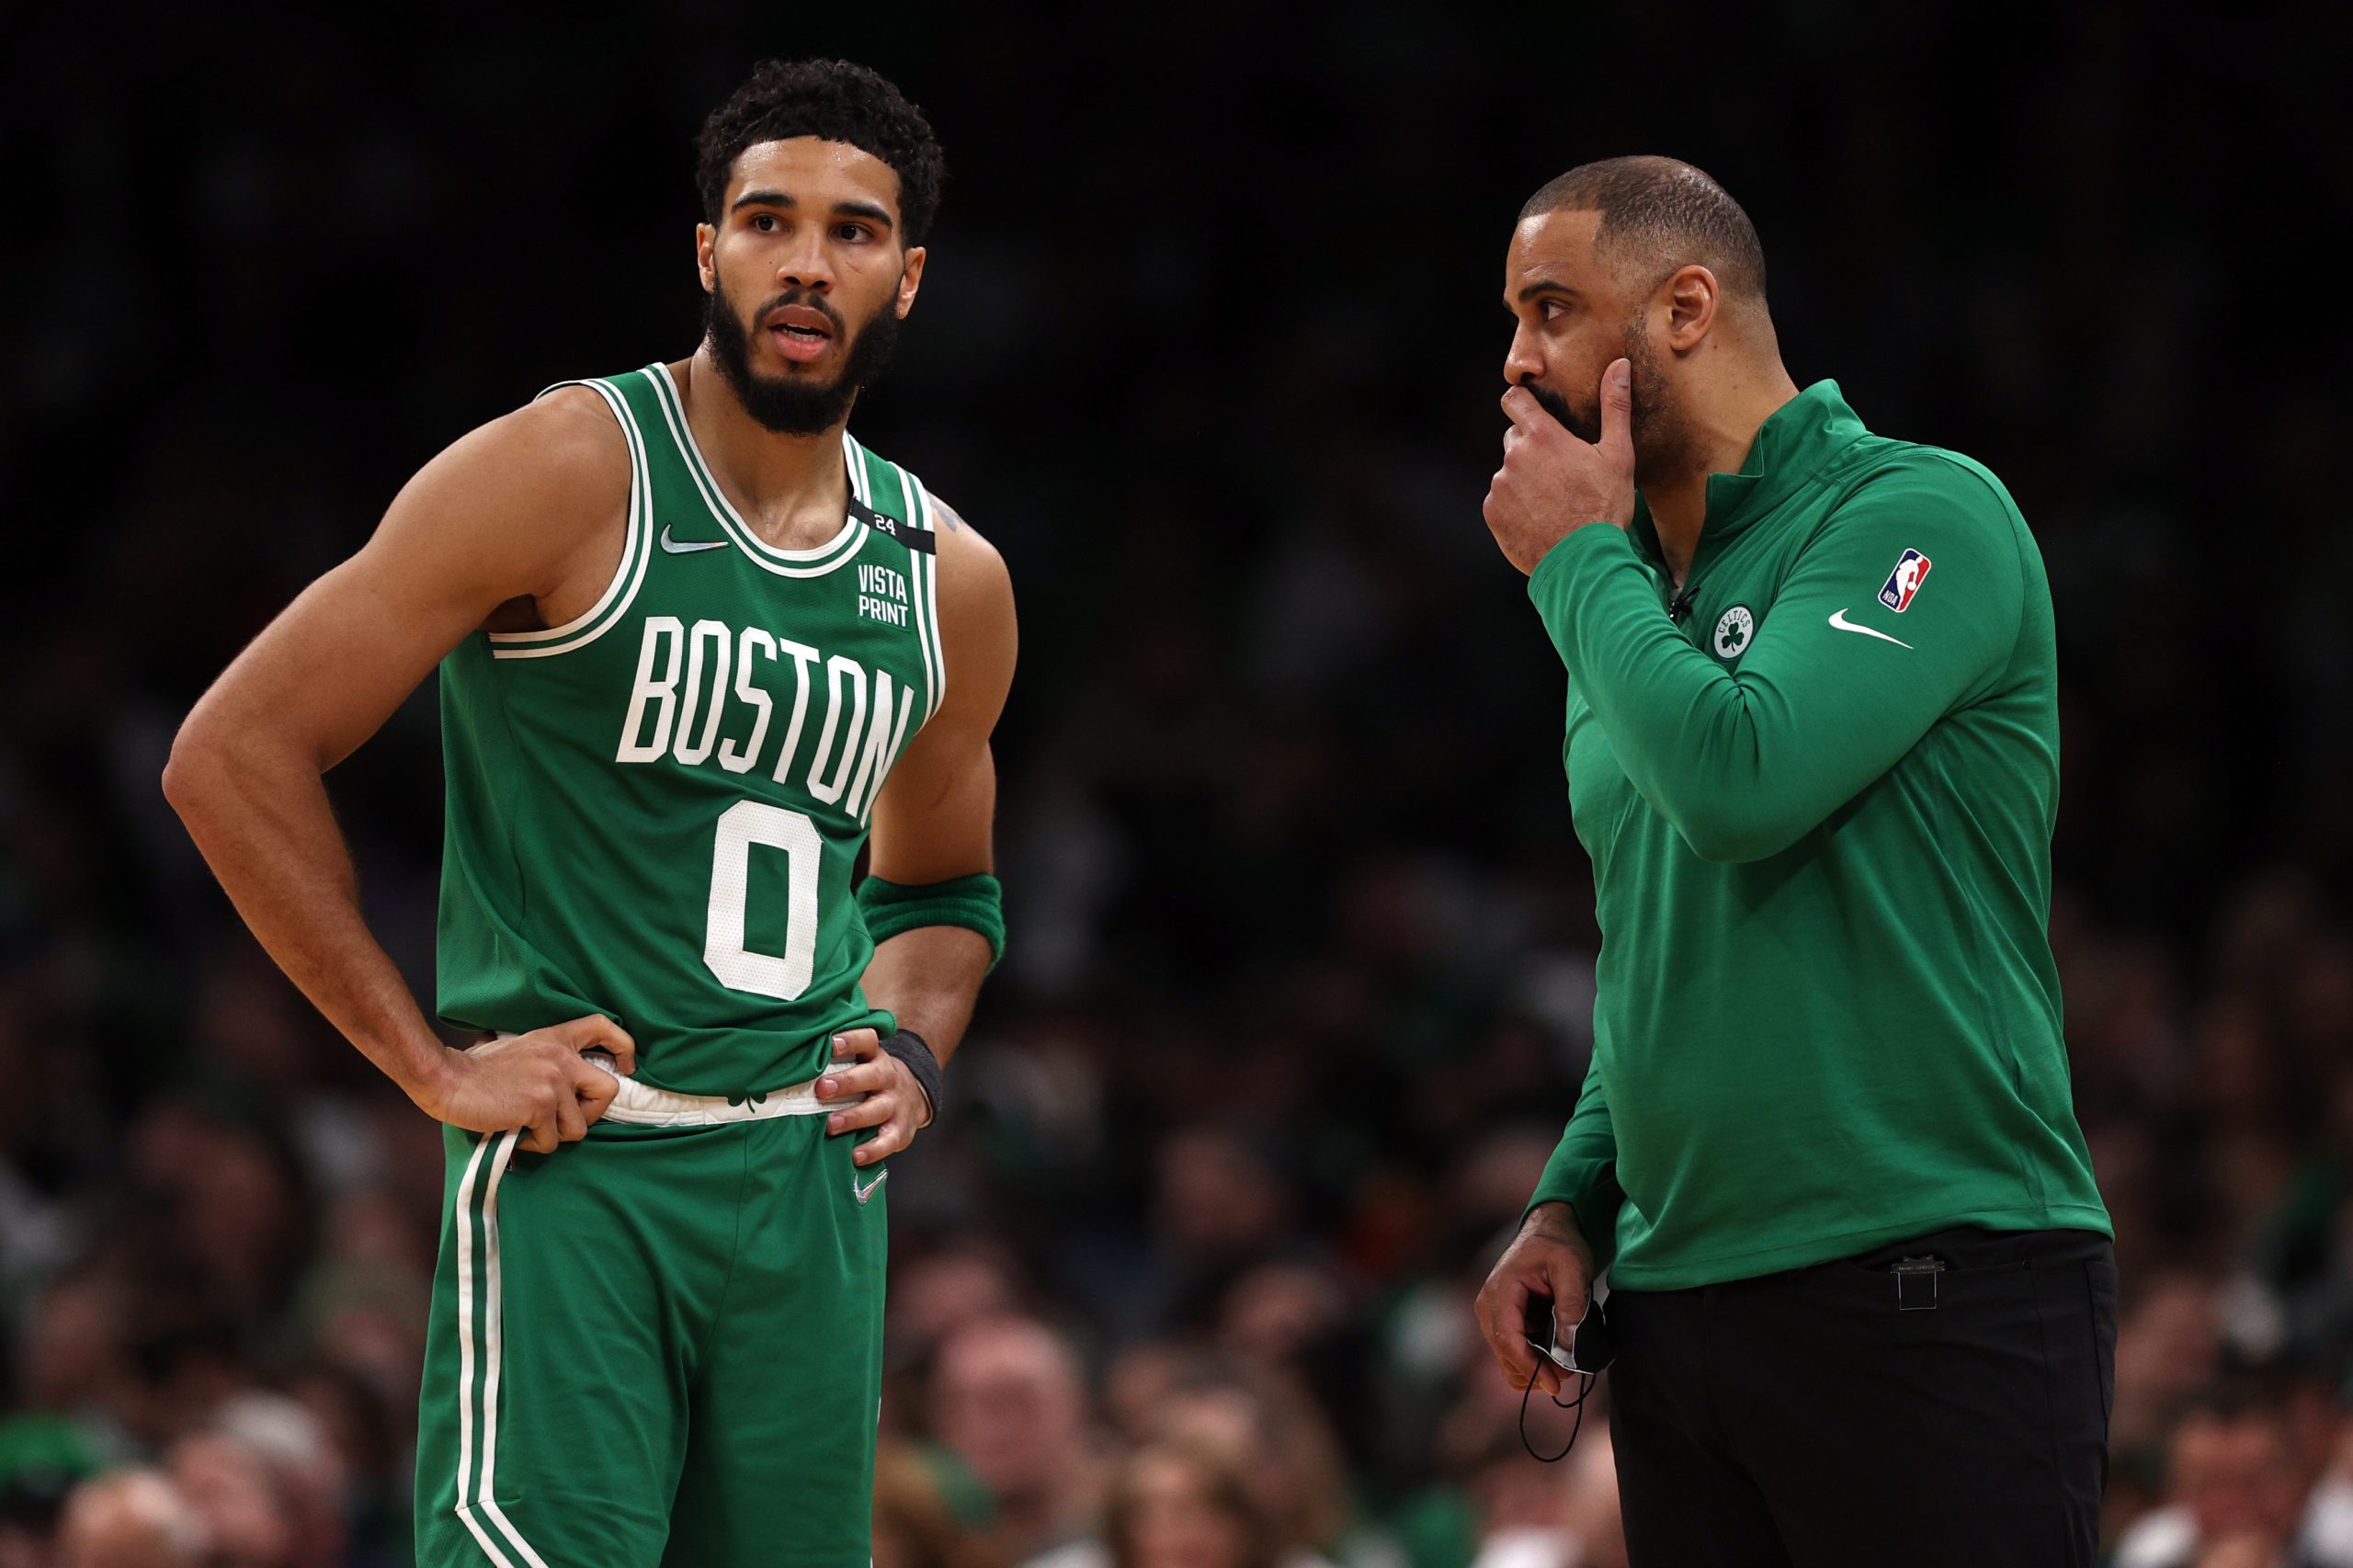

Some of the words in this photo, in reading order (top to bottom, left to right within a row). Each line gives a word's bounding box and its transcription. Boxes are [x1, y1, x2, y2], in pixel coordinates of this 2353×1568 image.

[874, 514, 896, 536] 24
[858, 564, 908, 605] VISTA
[1881, 589, 1899, 607] NBA
[858, 595, 909, 628] PRINT
[1717, 609, 1751, 633] CELTICS
[615, 616, 915, 829] BOSTON
[702, 799, 824, 1002] 0
